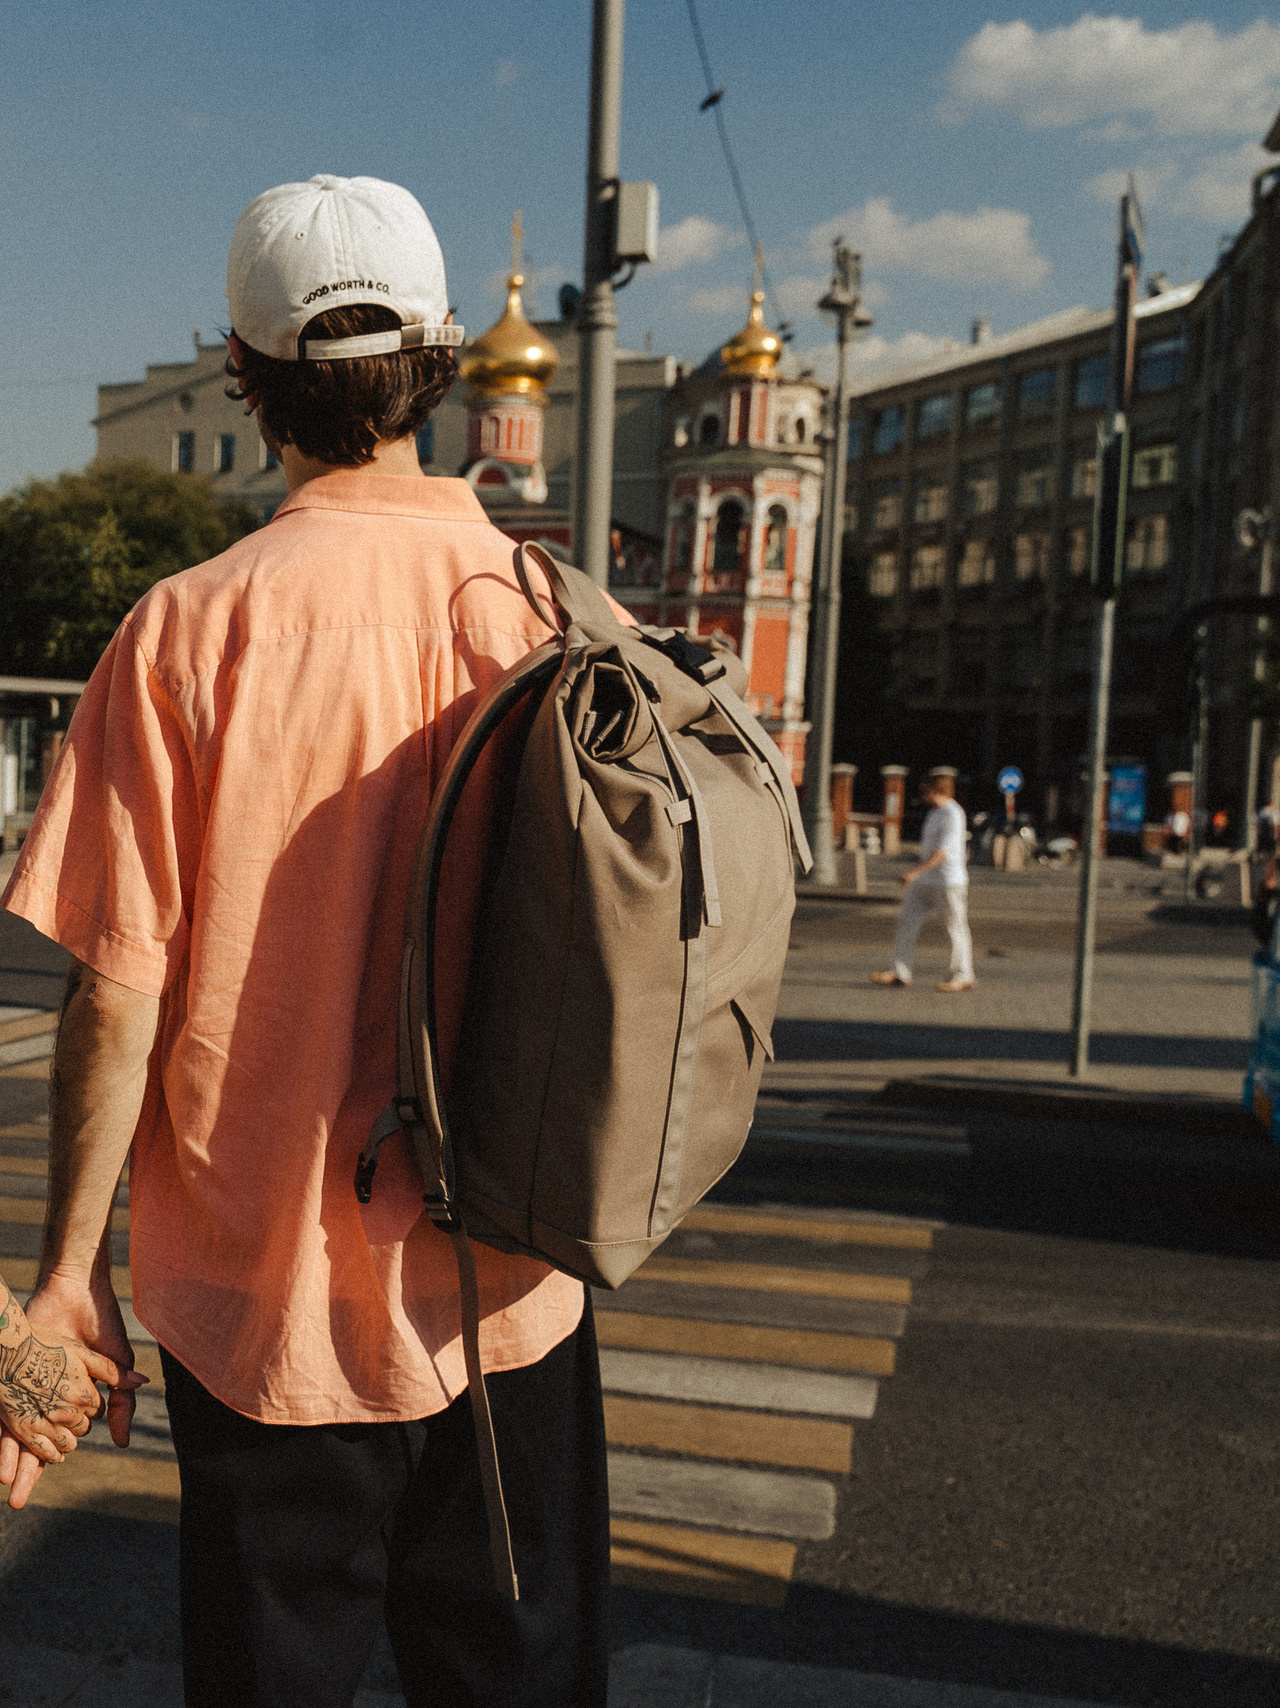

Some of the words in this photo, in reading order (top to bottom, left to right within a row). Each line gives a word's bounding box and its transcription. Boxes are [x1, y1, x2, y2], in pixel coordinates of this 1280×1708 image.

[302, 285, 329, 305] GOOD
[331, 280, 365, 292] WORTH
[367, 280, 373, 289] &
[376, 282, 390, 295] CO.
[20, 1351, 41, 1380] Witch
